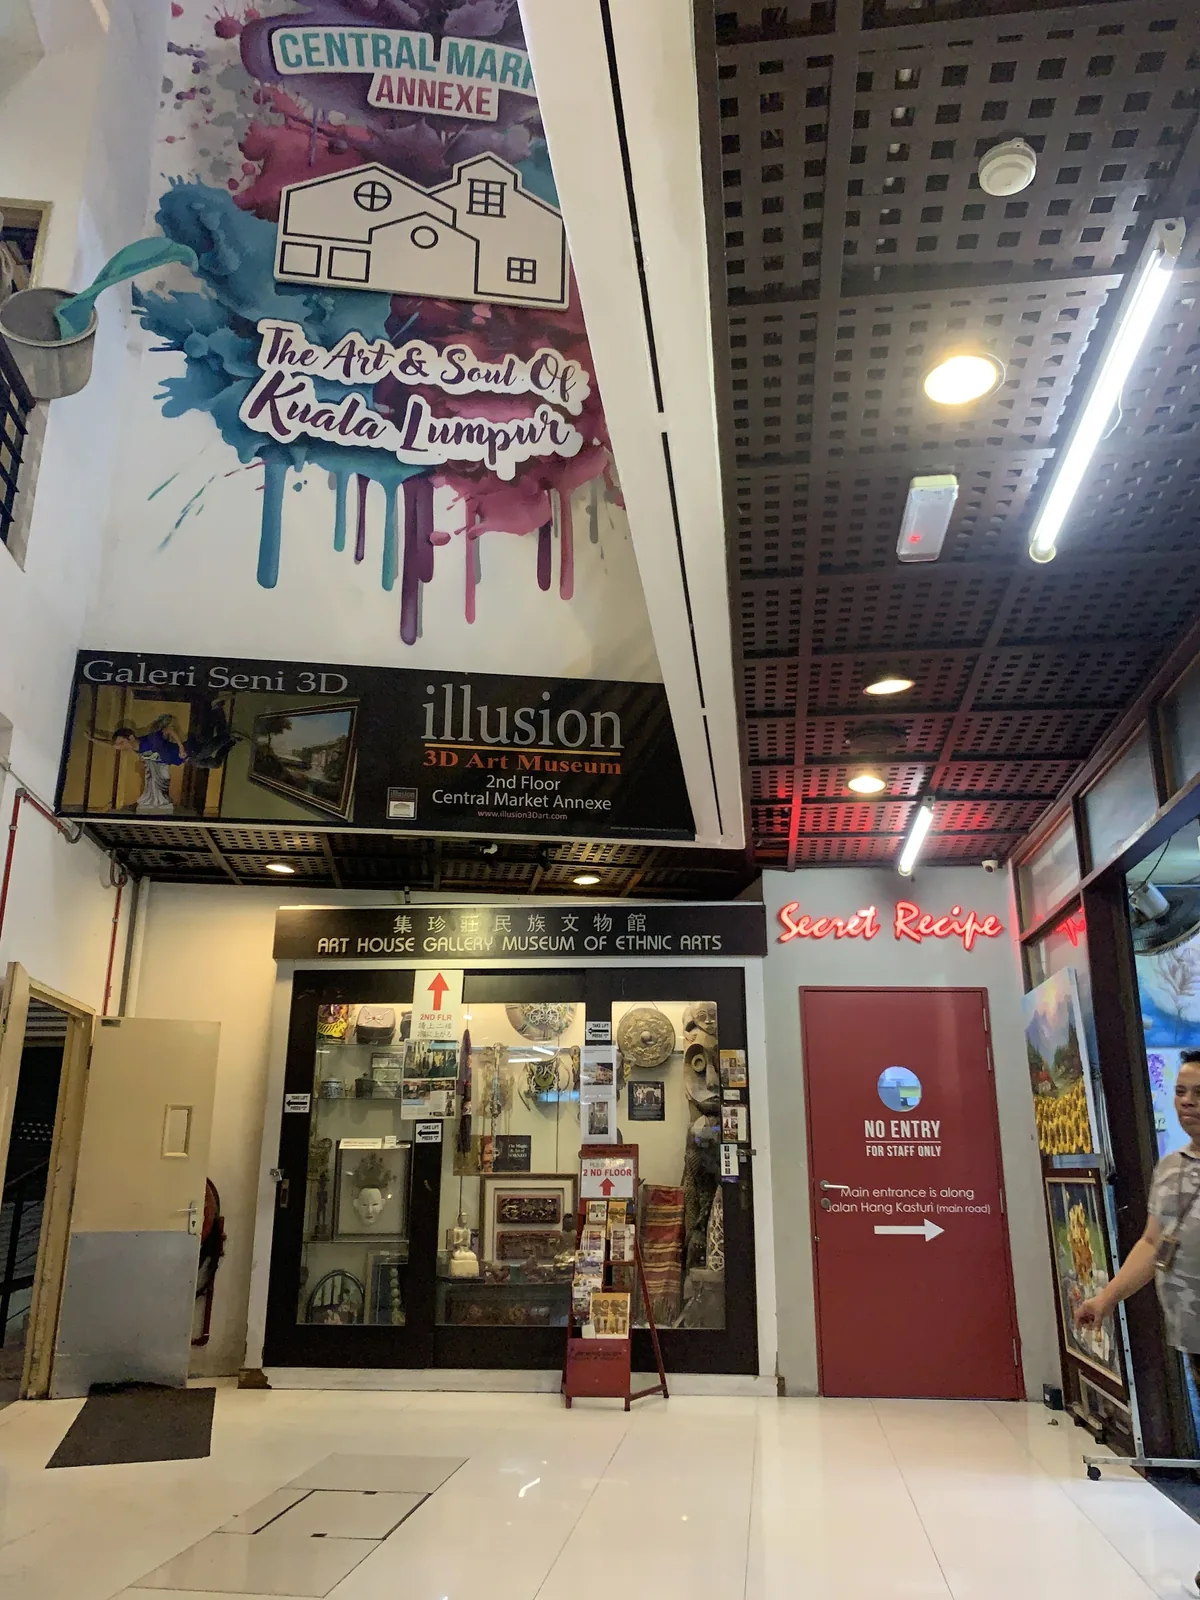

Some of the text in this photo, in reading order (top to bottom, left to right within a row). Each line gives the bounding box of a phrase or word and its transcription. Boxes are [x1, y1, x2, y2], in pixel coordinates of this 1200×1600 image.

[278, 32, 440, 73] CENTRAL
[375, 75, 493, 116] ANNEXE
[265, 326, 577, 402] The Art & Soul Of
[247, 369, 570, 466] Kuala Lumpur
[82, 653, 348, 694] Galeri Seni 3D
[420, 683, 625, 750] illusion
[422, 750, 622, 776] 3D Art Museum
[485, 774, 561, 791] 2nd Floor
[431, 789, 612, 811] Central Market Annexe
[777, 901, 1004, 950] Secret Recipe
[317, 934, 723, 954] ART HOUSE GALLERY MUSEUM OF ETHNIC ARTS
[419, 1013, 453, 1021] 2ND FLR
[864, 1119, 941, 1138] NO ENTRY
[865, 1145, 942, 1157] FOR STAFF ONLY
[583, 1169, 632, 1177] 2 ND FLOOR
[840, 1186, 975, 1200] Main entrance is along
[861, 1202, 893, 1215] Hang
[896, 1201, 934, 1213] Kasturi
[936, 1204, 963, 1214] (main
[964, 1204, 991, 1214] road)
